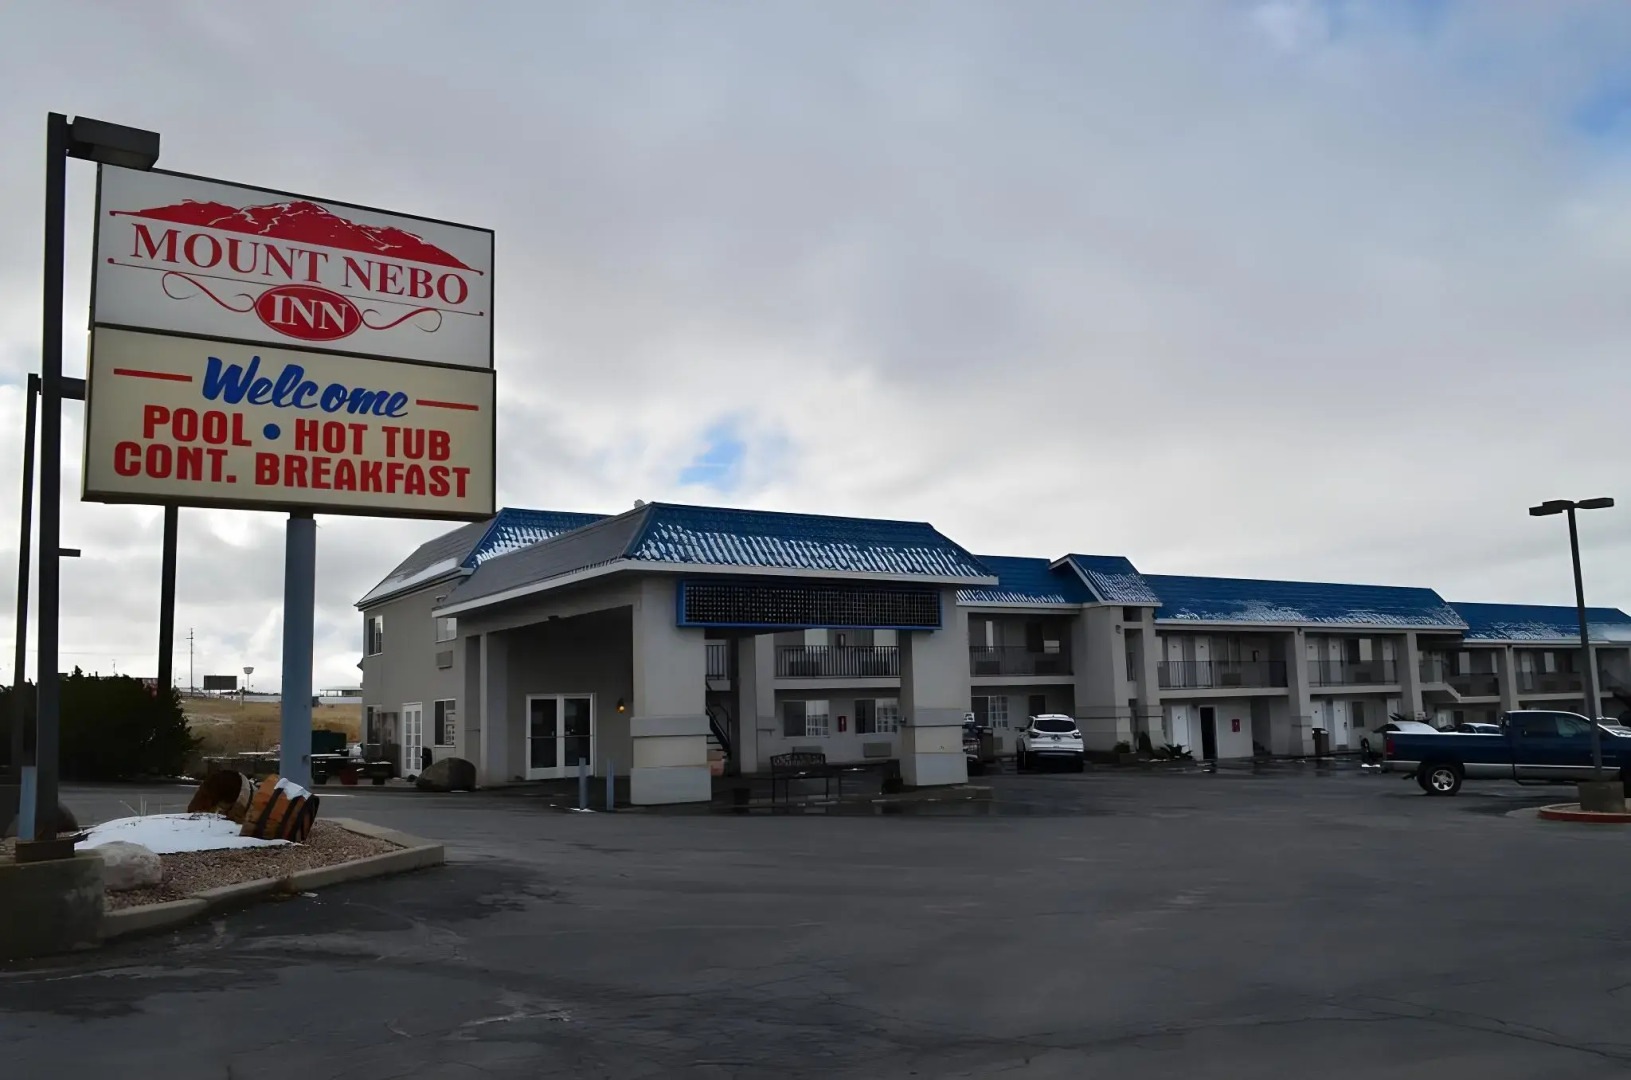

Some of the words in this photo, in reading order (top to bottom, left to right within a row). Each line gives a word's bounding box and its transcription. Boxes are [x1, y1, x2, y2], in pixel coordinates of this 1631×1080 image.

[130, 223, 328, 284] MOUNT
[342, 255, 469, 305] NEBO
[270, 293, 348, 333] INN
[202, 356, 409, 418] Welcome
[143, 405, 252, 447] POOL
[294, 418, 368, 456] HOT
[381, 425, 452, 462] TUB
[114, 441, 237, 483] CONT.
[254, 453, 471, 498] BREAKFAST
